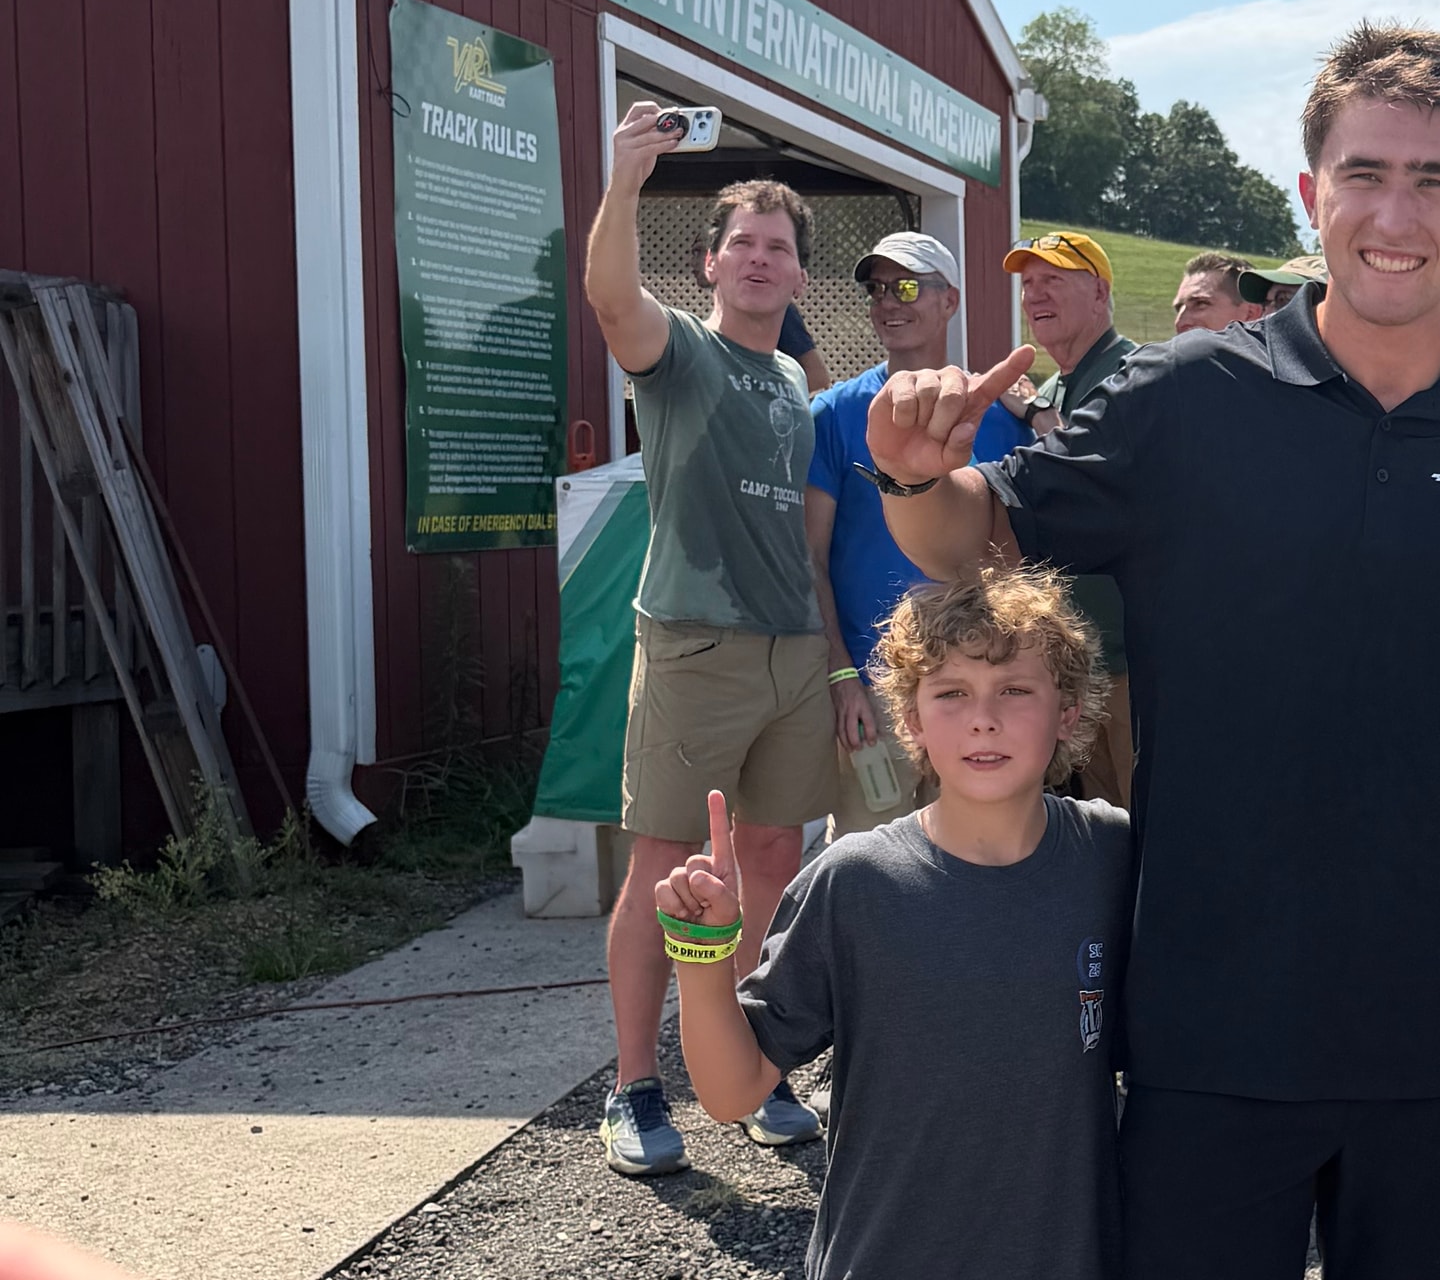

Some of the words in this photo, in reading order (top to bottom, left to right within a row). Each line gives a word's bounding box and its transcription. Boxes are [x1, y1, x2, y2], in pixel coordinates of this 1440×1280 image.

[469, 86, 485, 102] KART
[485, 91, 506, 108] TRACK
[421, 101, 478, 148] TRACK
[481, 121, 538, 163] RULES
[908, 79, 997, 173] RACEWAY
[740, 479, 770, 498] CAMP
[417, 516, 430, 535] IN
[431, 515, 456, 534] CASE
[459, 515, 472, 532] OF
[473, 514, 527, 532] EMERGENCY
[527, 513, 547, 530] DIAL
[680, 947, 716, 958] DRIVER
